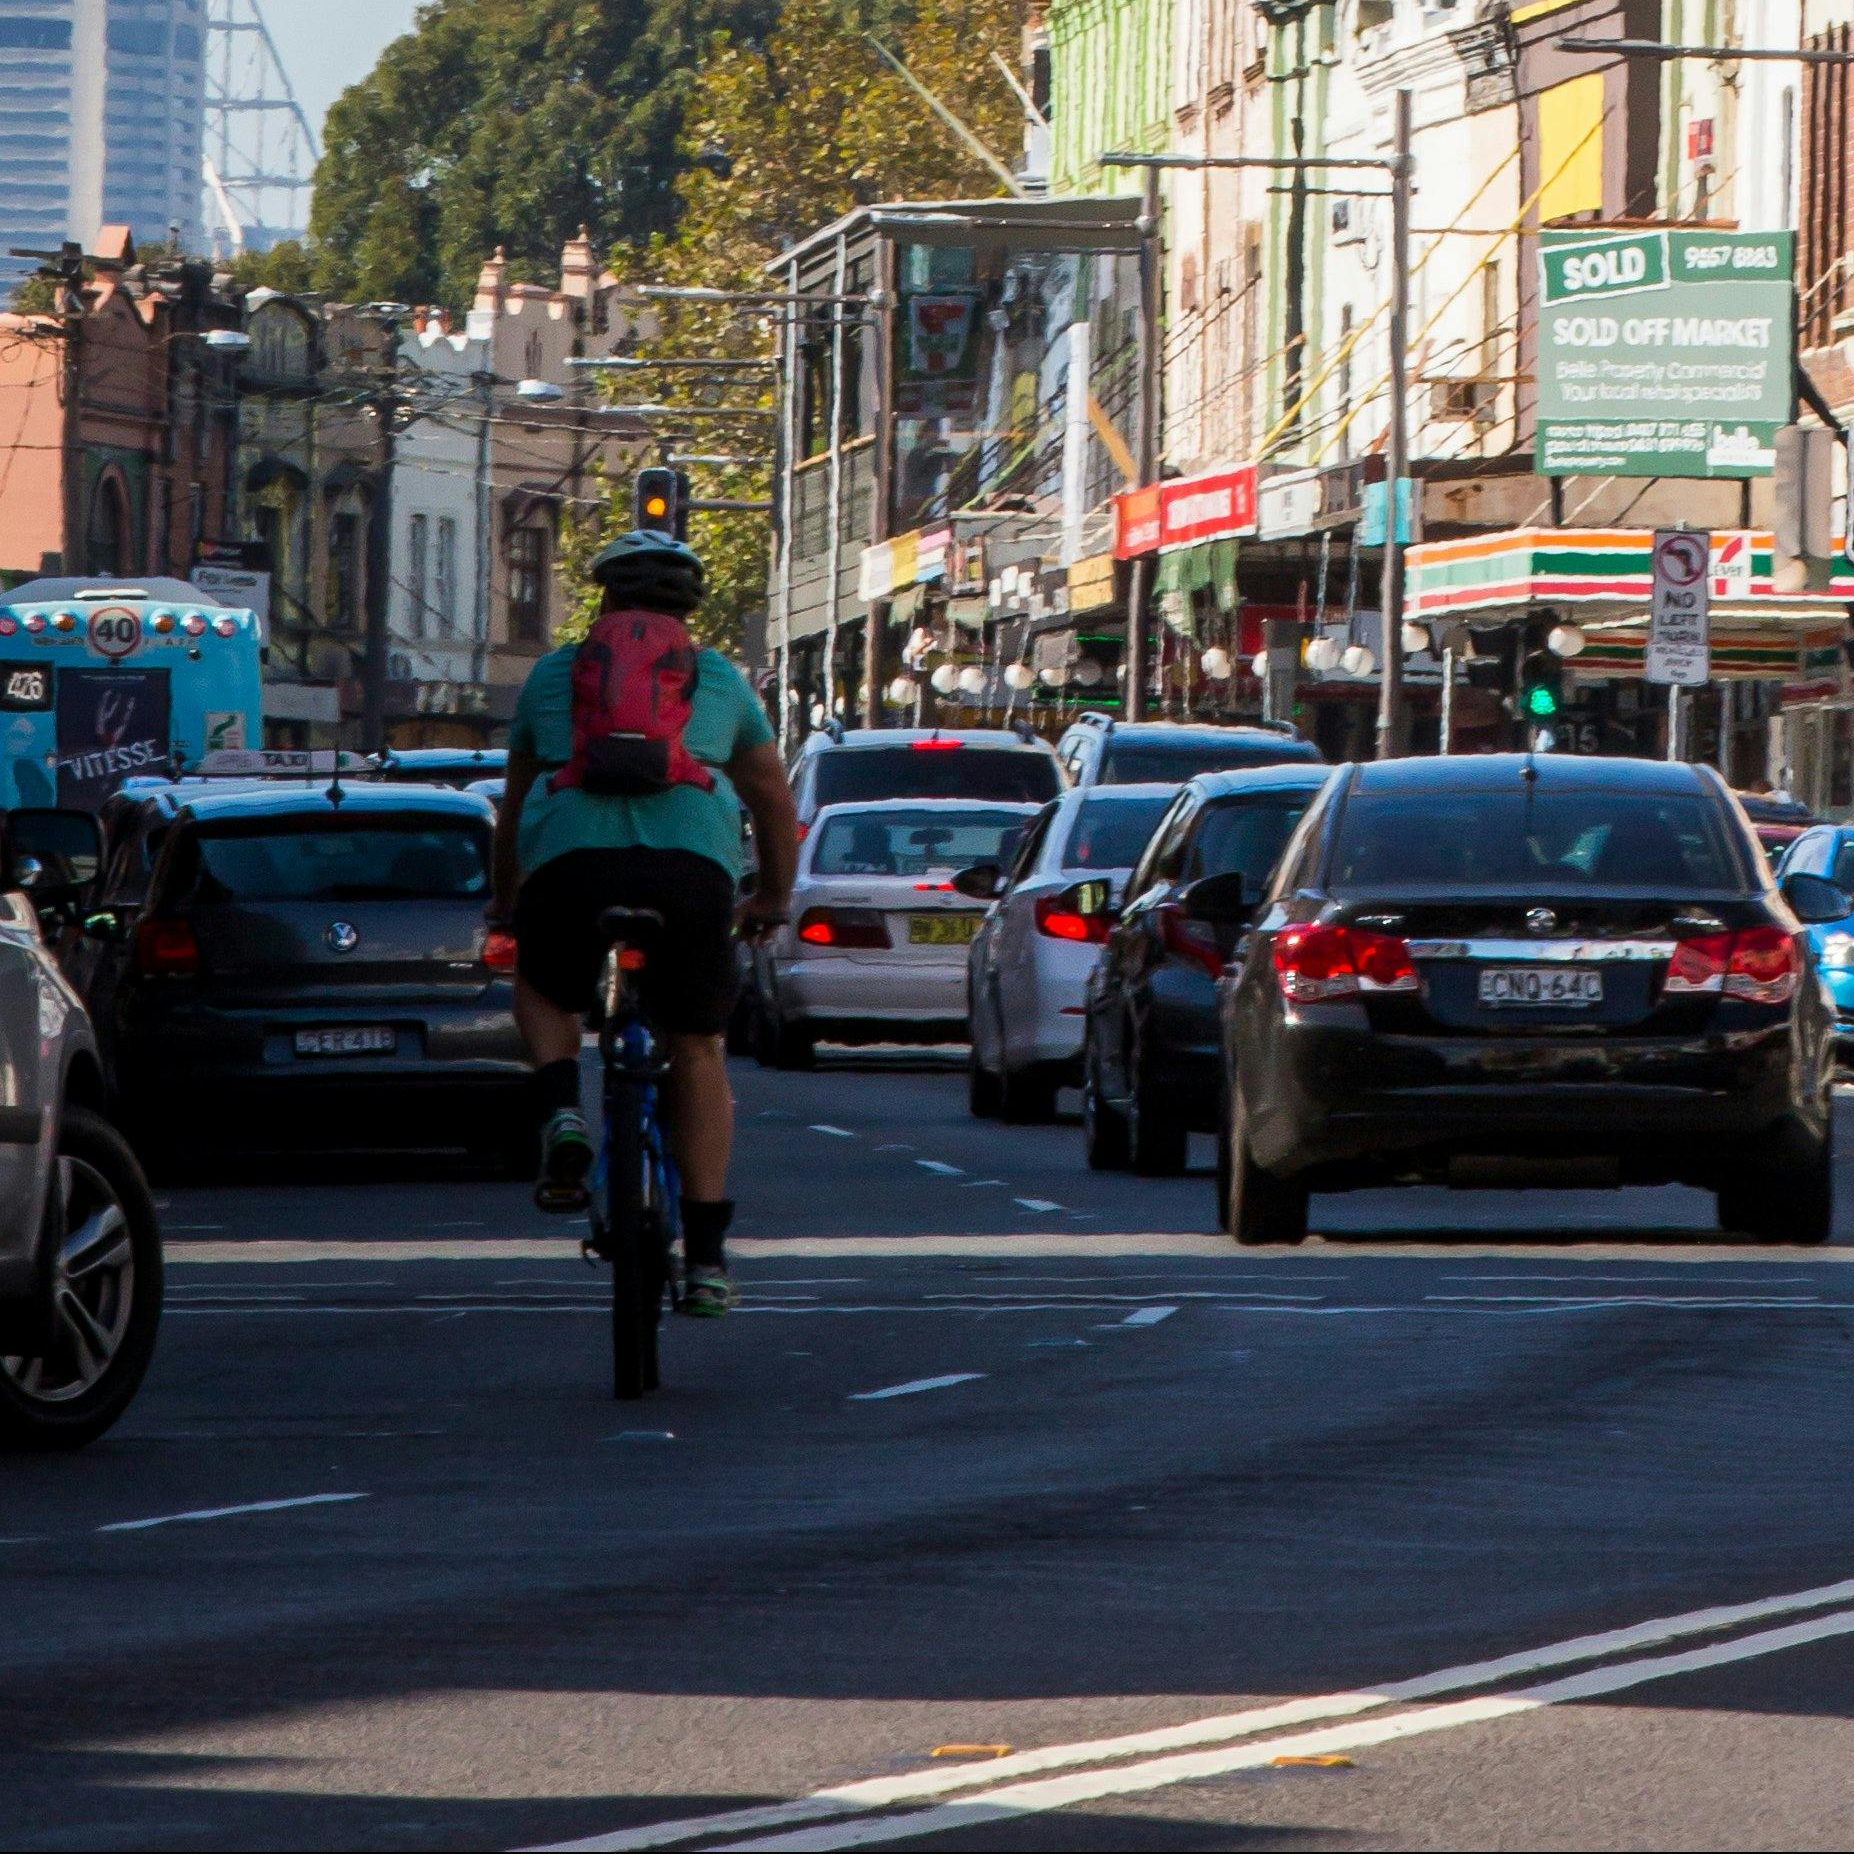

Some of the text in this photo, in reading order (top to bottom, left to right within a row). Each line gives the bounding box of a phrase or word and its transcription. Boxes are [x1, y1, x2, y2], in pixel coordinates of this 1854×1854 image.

[1563, 247, 1647, 290] SOLD
[1553, 317, 1773, 348] SOLD OFF MARKET
[1663, 591, 1697, 609] NO
[97, 618, 135, 642] 40
[1660, 614, 1699, 627] LEFT
[69, 739, 157, 781] VITESSE
